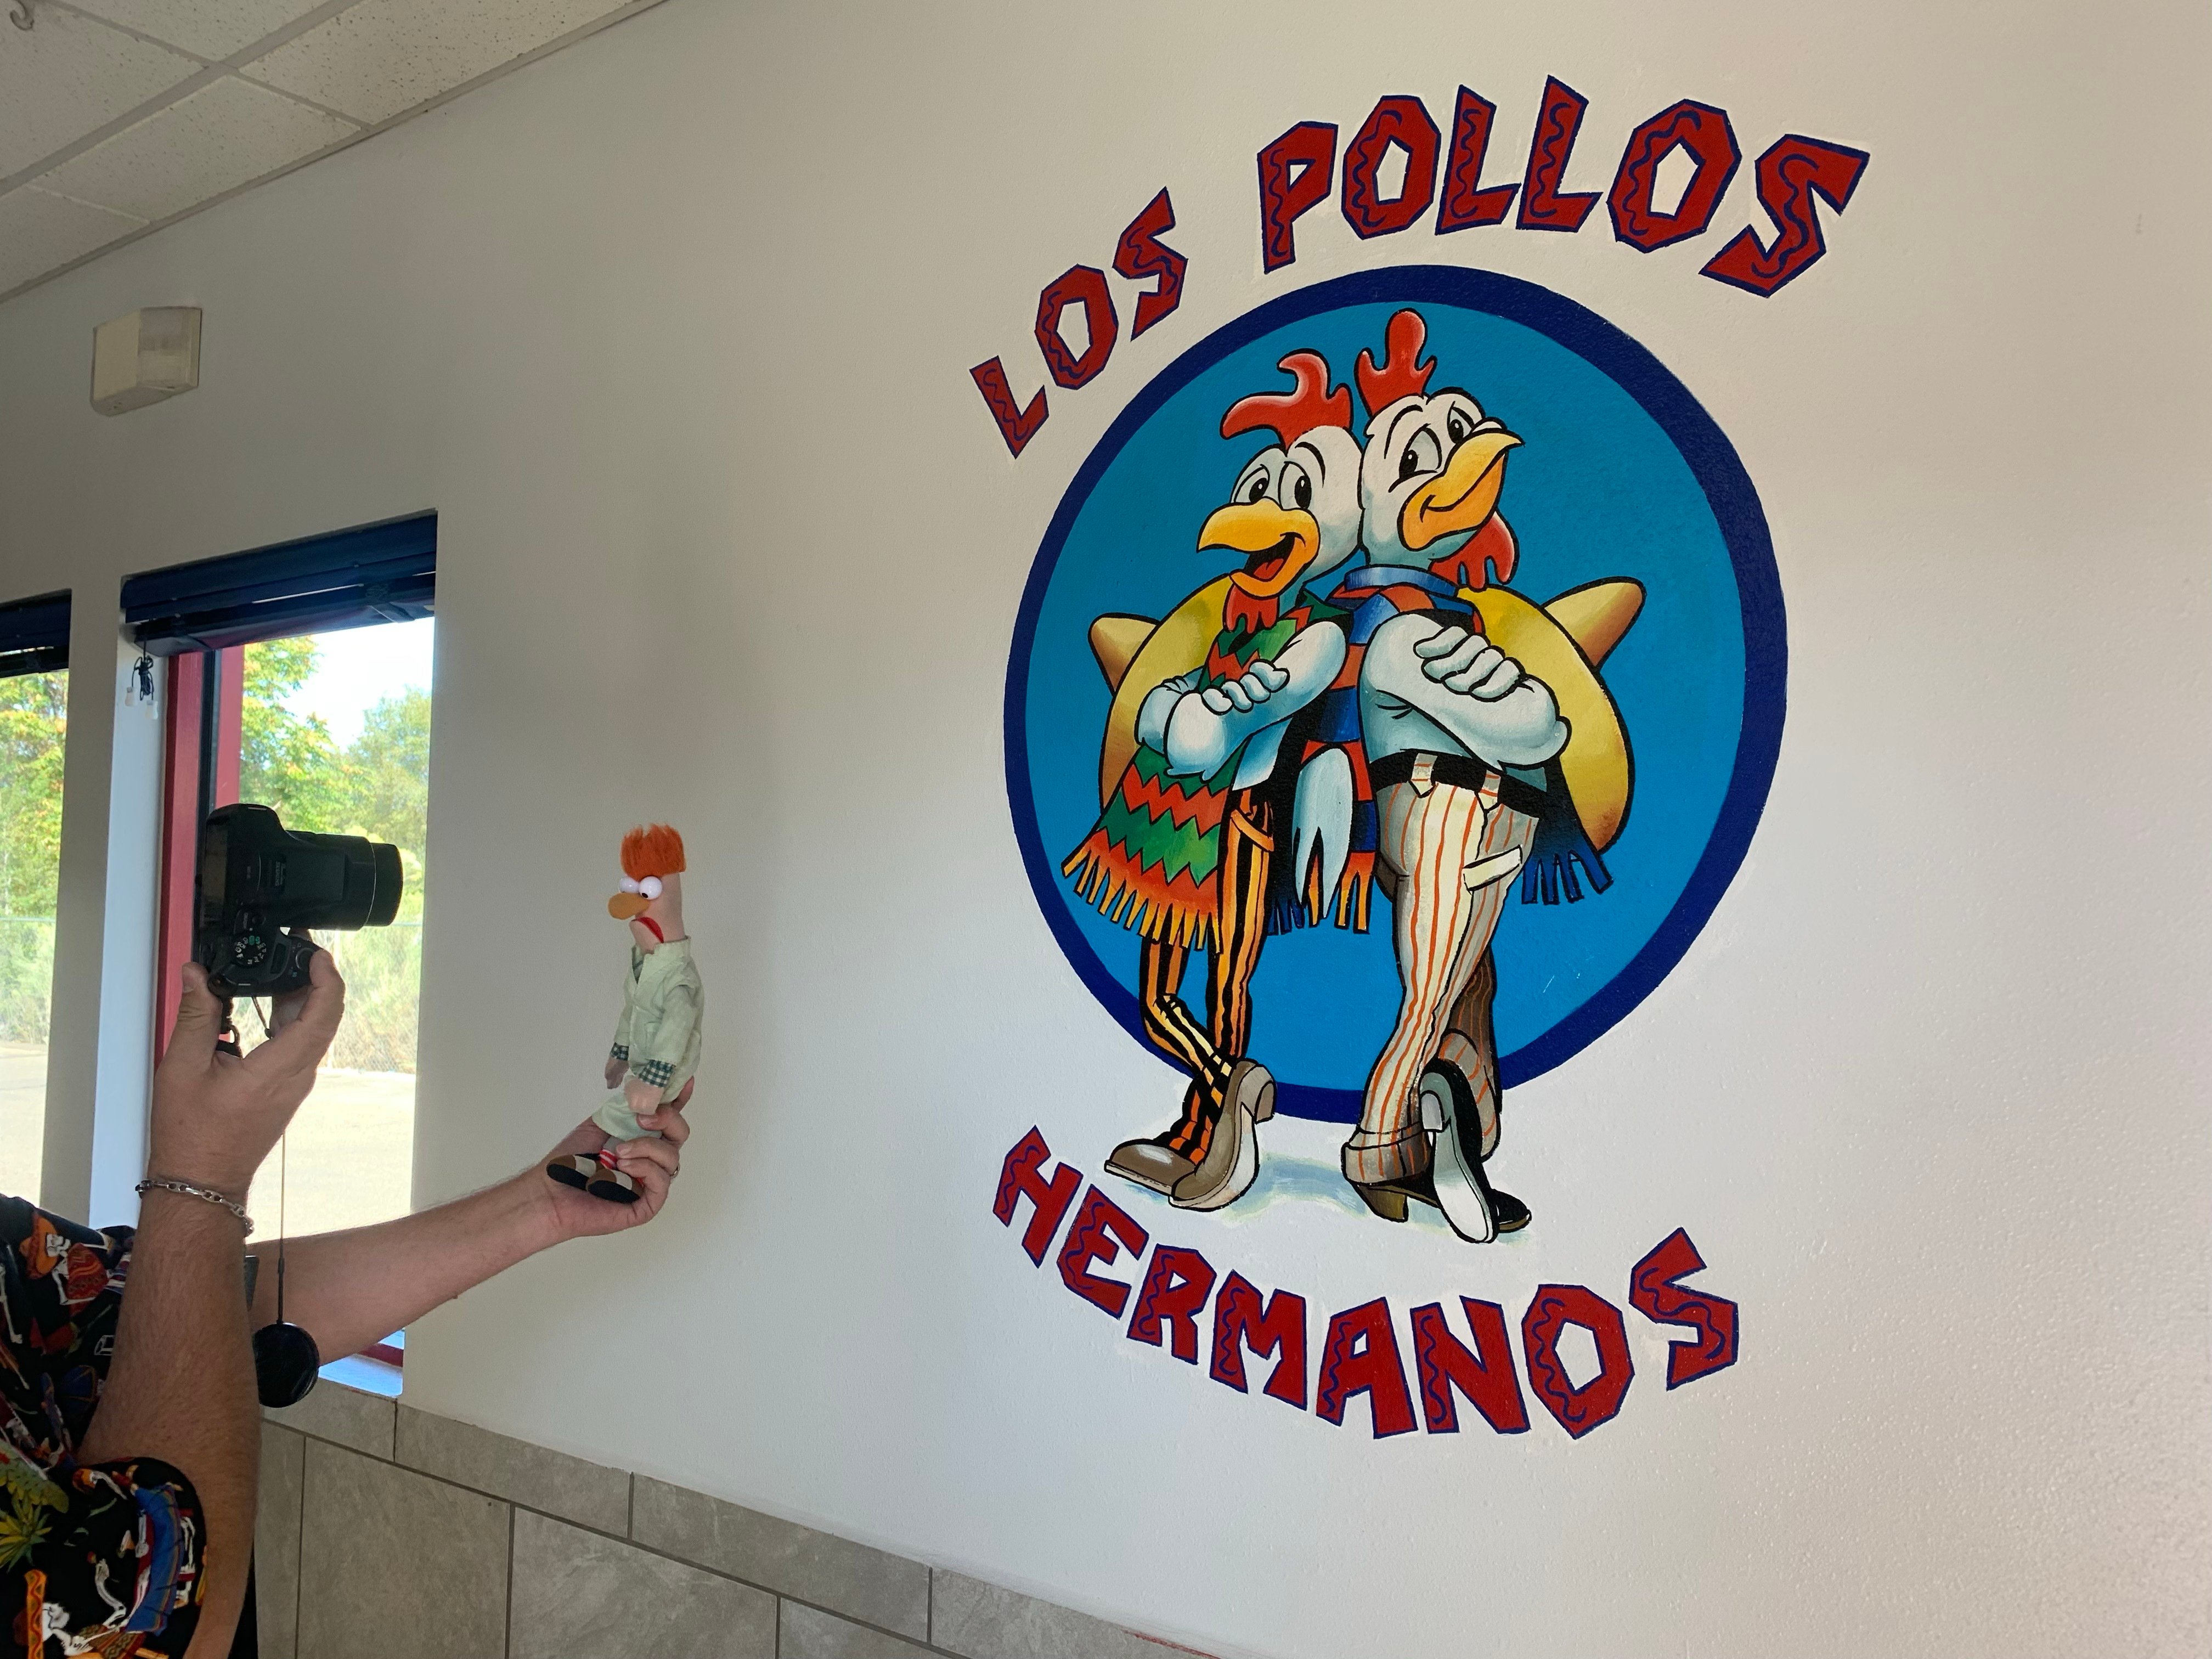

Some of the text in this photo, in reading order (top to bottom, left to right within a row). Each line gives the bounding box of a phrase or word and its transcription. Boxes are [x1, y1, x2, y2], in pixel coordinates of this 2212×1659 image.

[970, 75, 1870, 457] LOS POLLOS
[992, 1125, 1739, 1440] HERMANOS
